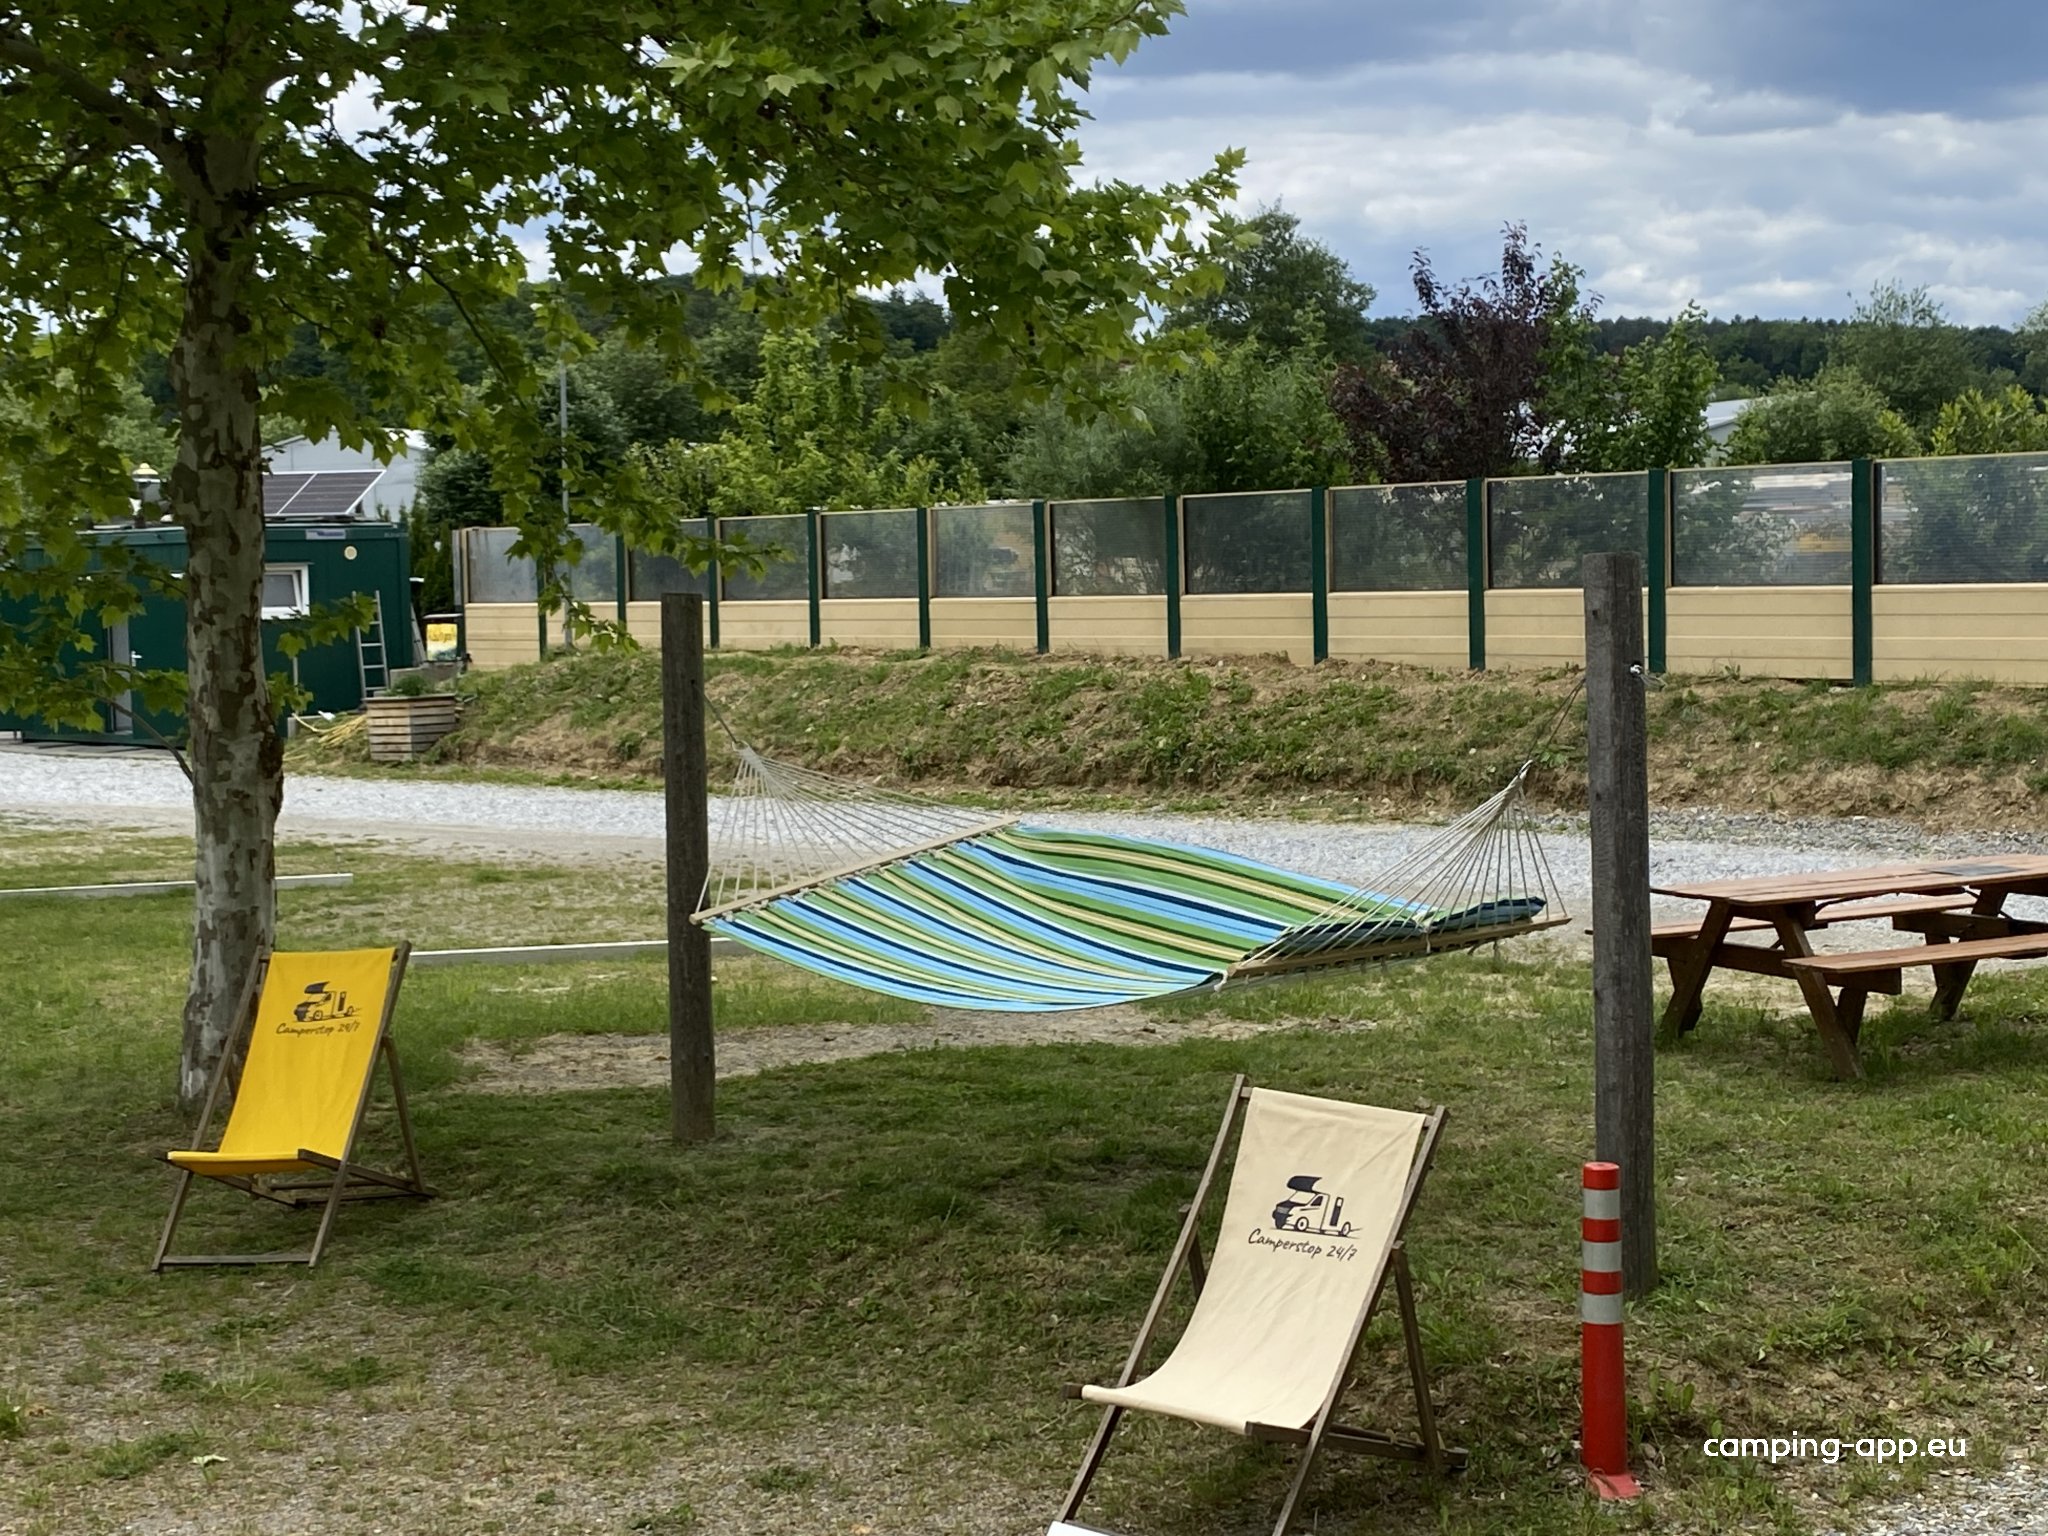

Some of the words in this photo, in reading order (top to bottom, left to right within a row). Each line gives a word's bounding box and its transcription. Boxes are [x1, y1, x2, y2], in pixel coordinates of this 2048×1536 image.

[276, 1022, 334, 1038] Camperstop
[338, 1020, 361, 1032] 24/7
[1248, 1228, 1322, 1259] Camperstop
[1326, 1244, 1358, 1261] 24/7
